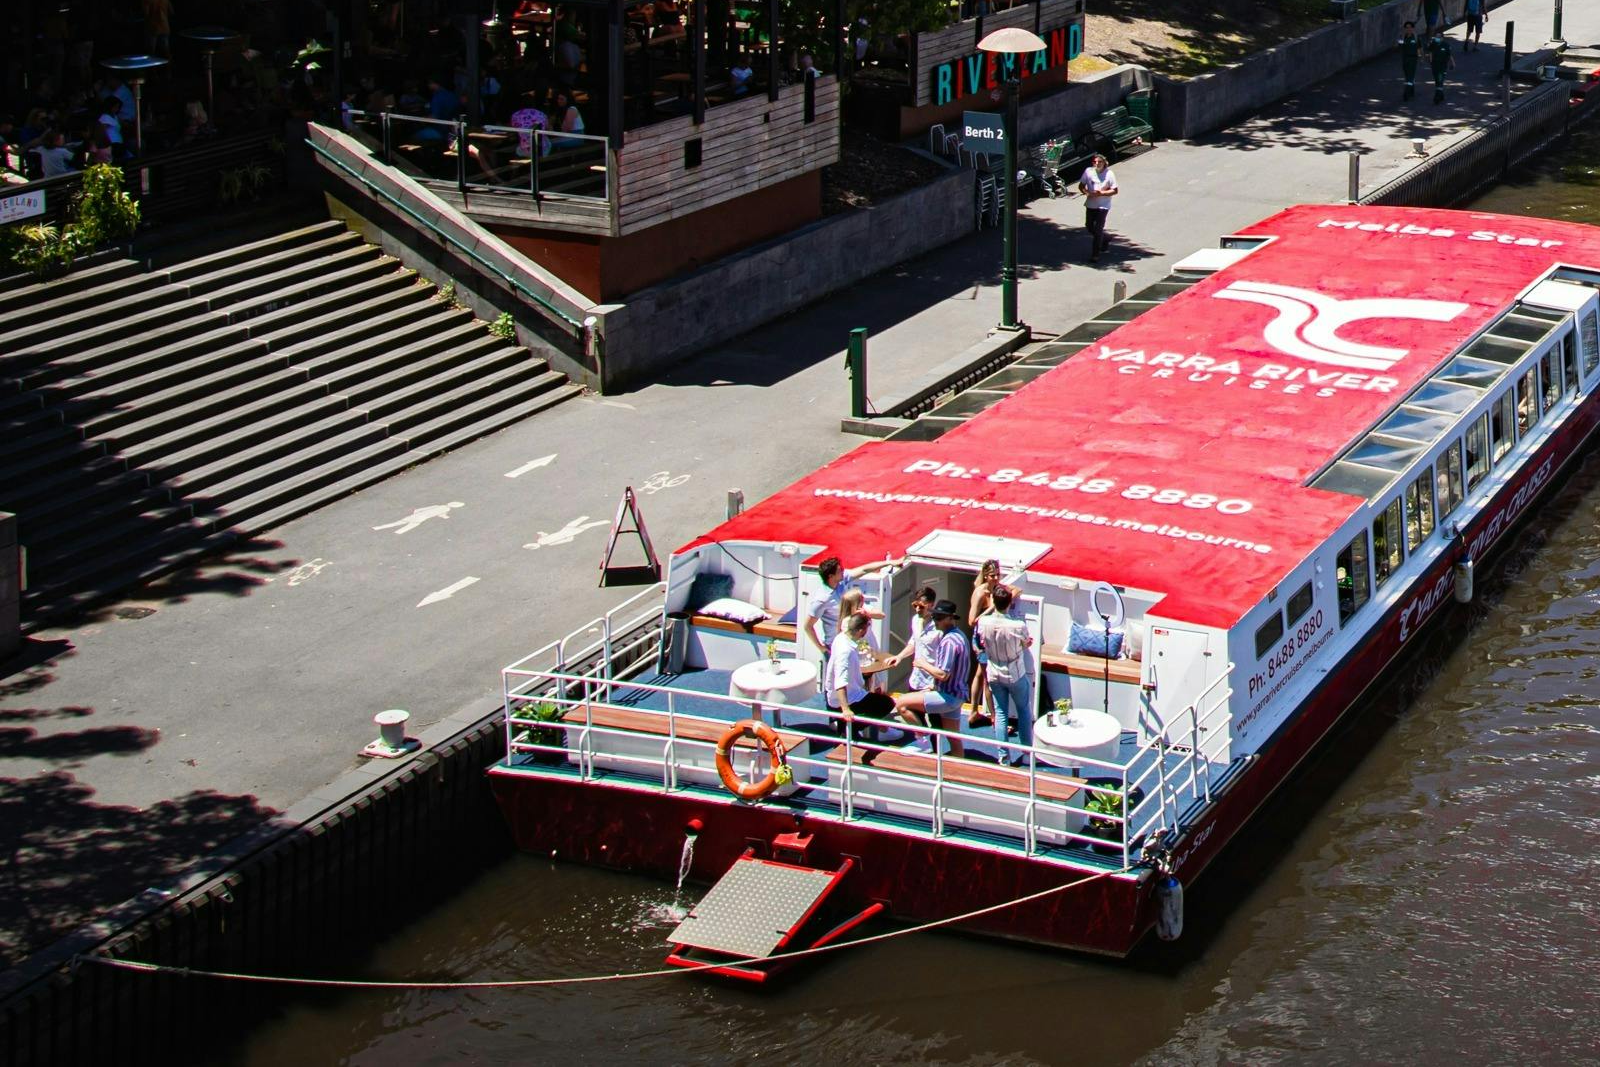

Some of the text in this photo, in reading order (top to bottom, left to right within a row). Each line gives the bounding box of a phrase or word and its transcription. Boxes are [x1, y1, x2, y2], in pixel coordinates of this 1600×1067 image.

[965, 125, 1004, 140] Berth 2
[1317, 219, 1564, 249] Melba Star
[1096, 345, 1399, 393] YARRA RIVER
[1118, 365, 1337, 398] CRUISES
[902, 459, 1254, 516] Ph: 8488 8880
[1468, 510, 1505, 561] RIVER
[1505, 452, 1555, 521] CRUISES
[813, 486, 1273, 554] www.yarrarivercruises.melbourne
[1236, 627, 1334, 732] www.yarrarivercruises.melbourne
[1248, 609, 1323, 700] Ph: 8488 8880
